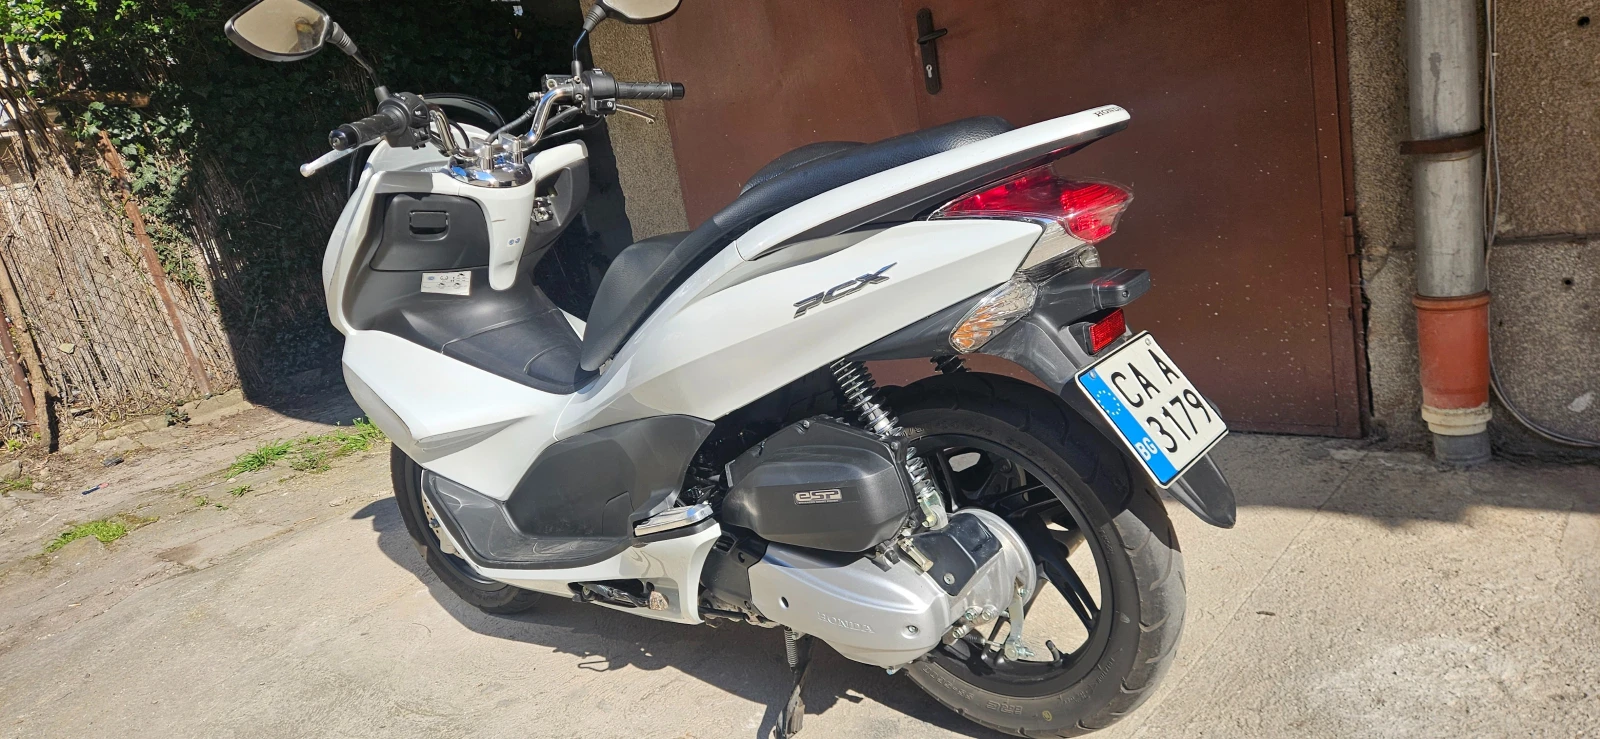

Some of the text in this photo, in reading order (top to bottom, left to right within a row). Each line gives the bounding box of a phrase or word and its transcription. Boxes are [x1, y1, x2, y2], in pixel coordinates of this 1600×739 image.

[793, 262, 897, 319] PCX
[1110, 348, 1180, 409] CA A
[1134, 436, 1158, 462] BG
[1145, 388, 1212, 454] 3179
[816, 611, 875, 634] HONDA
